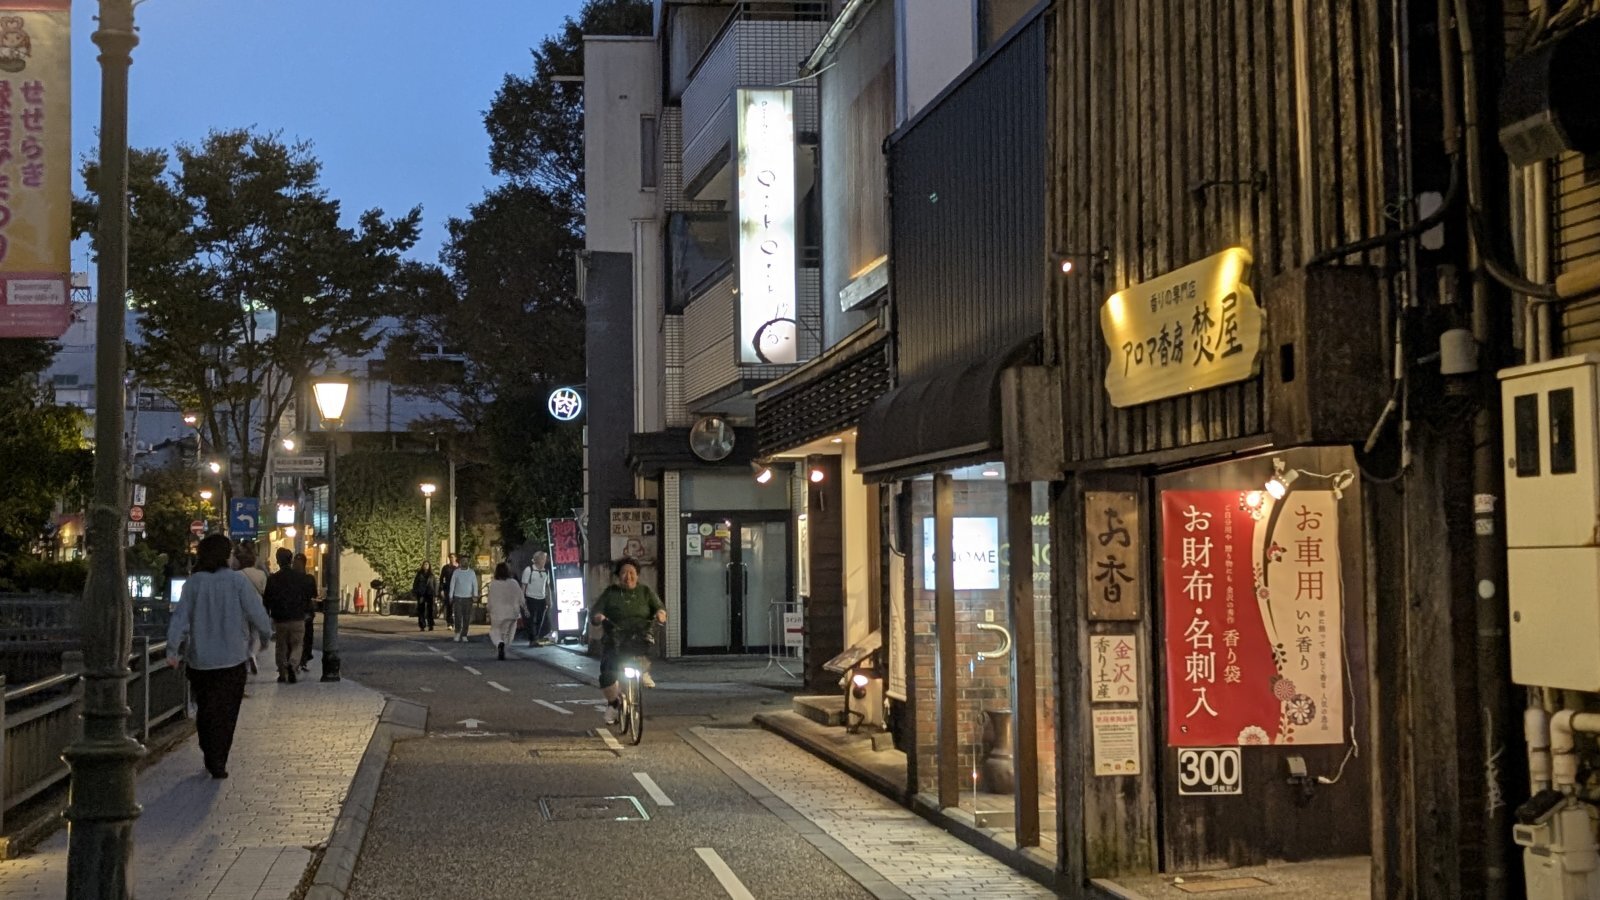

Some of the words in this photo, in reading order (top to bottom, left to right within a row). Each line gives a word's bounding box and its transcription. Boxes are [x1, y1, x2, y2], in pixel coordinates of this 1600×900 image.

[1150, 280, 1196, 313] 香りの専門店
[612, 511, 652, 522] 武家屋敷
[1094, 507, 1135, 604] お香
[1294, 505, 1325, 600] お車用
[1181, 504, 1219, 719] お財布・名刺入
[1296, 609, 1312, 671] いい香り
[1094, 636, 1113, 699] 香り土産
[1113, 639, 1135, 697] 金沢の
[1222, 629, 1241, 684] 香り袋
[1180, 749, 1240, 786] 300
